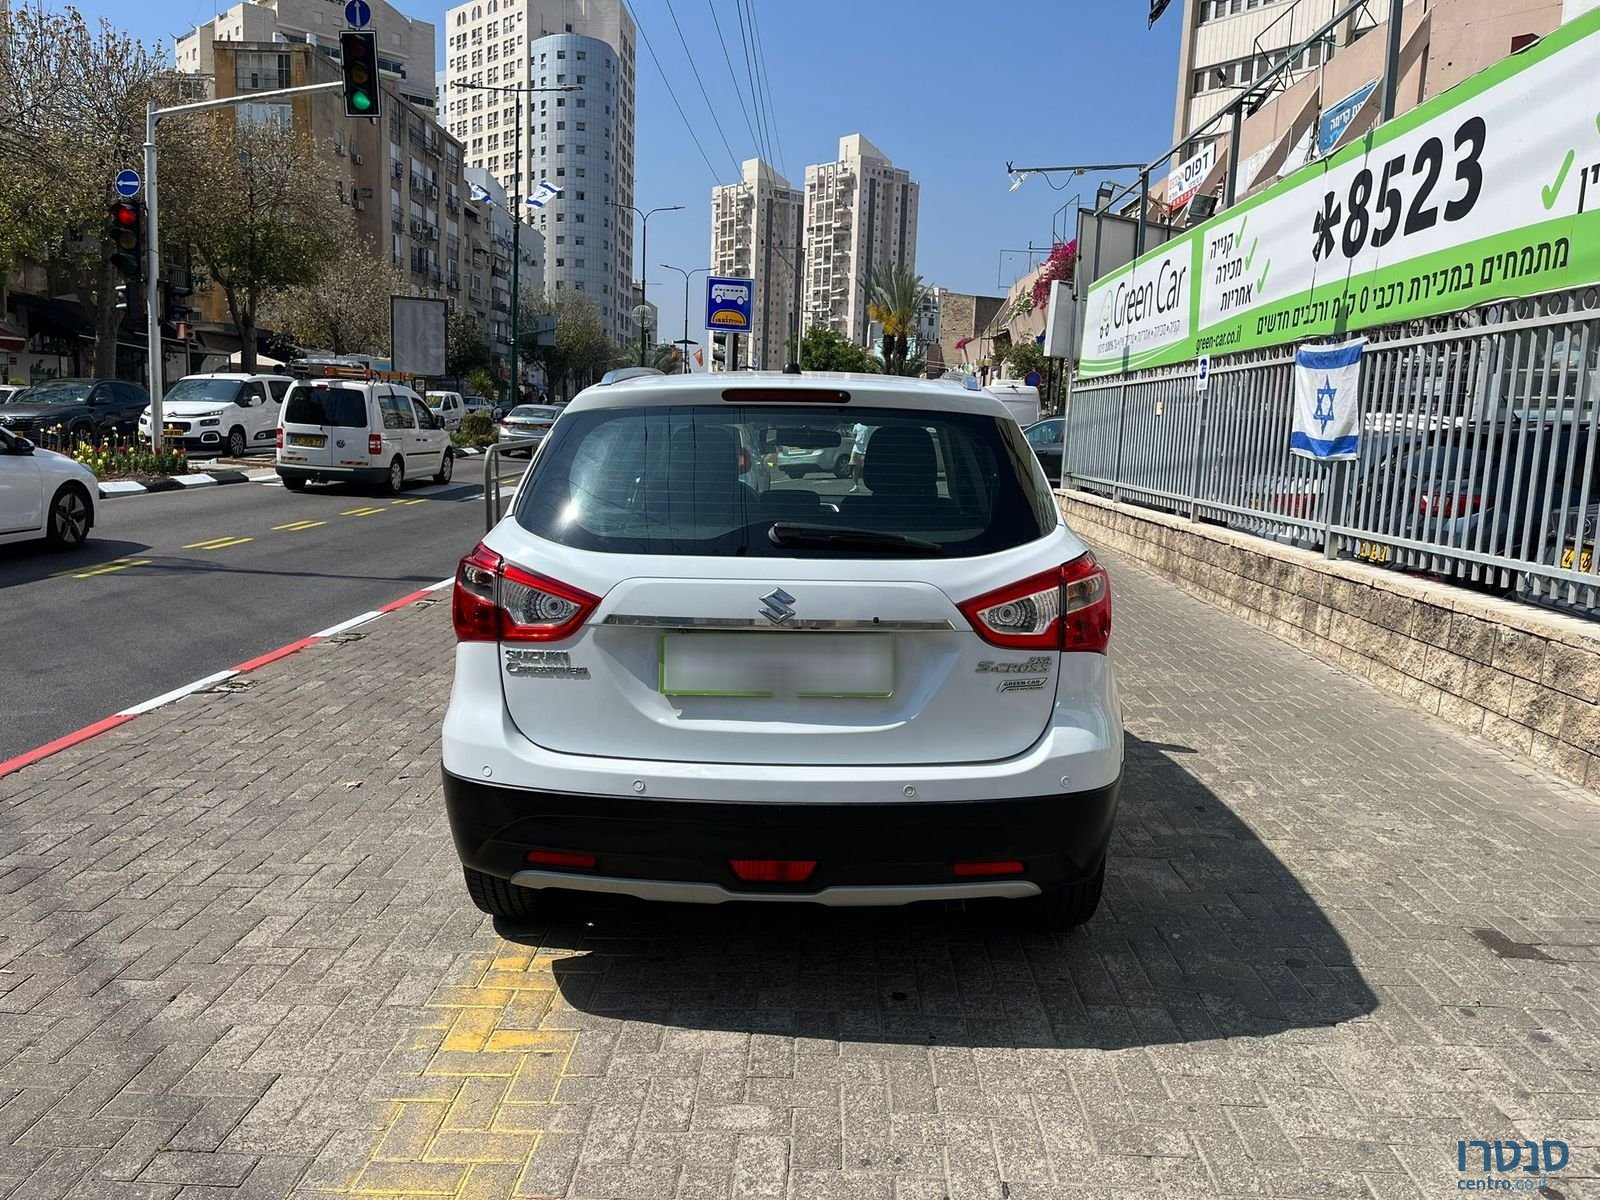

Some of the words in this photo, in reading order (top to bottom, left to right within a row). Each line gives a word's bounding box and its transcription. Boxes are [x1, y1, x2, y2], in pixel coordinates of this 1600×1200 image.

[1184, 152, 1209, 182] דפוס
[1210, 232, 1234, 260] קנייה
[1215, 257, 1242, 285] מכירה
[1480, 237, 1570, 286] מתמחים
[1113, 281, 1154, 330] Green
[1156, 258, 1187, 314] Car
[1220, 282, 1253, 311] אחריות
[1373, 281, 1404, 311] רכבי
[1407, 262, 1474, 303] במכירת
[1256, 310, 1290, 336] חדשים
[1292, 299, 1329, 327] ורכבים
[1195, 323, 1243, 355] green-car.co.il
[505, 649, 570, 662] SUZUKI
